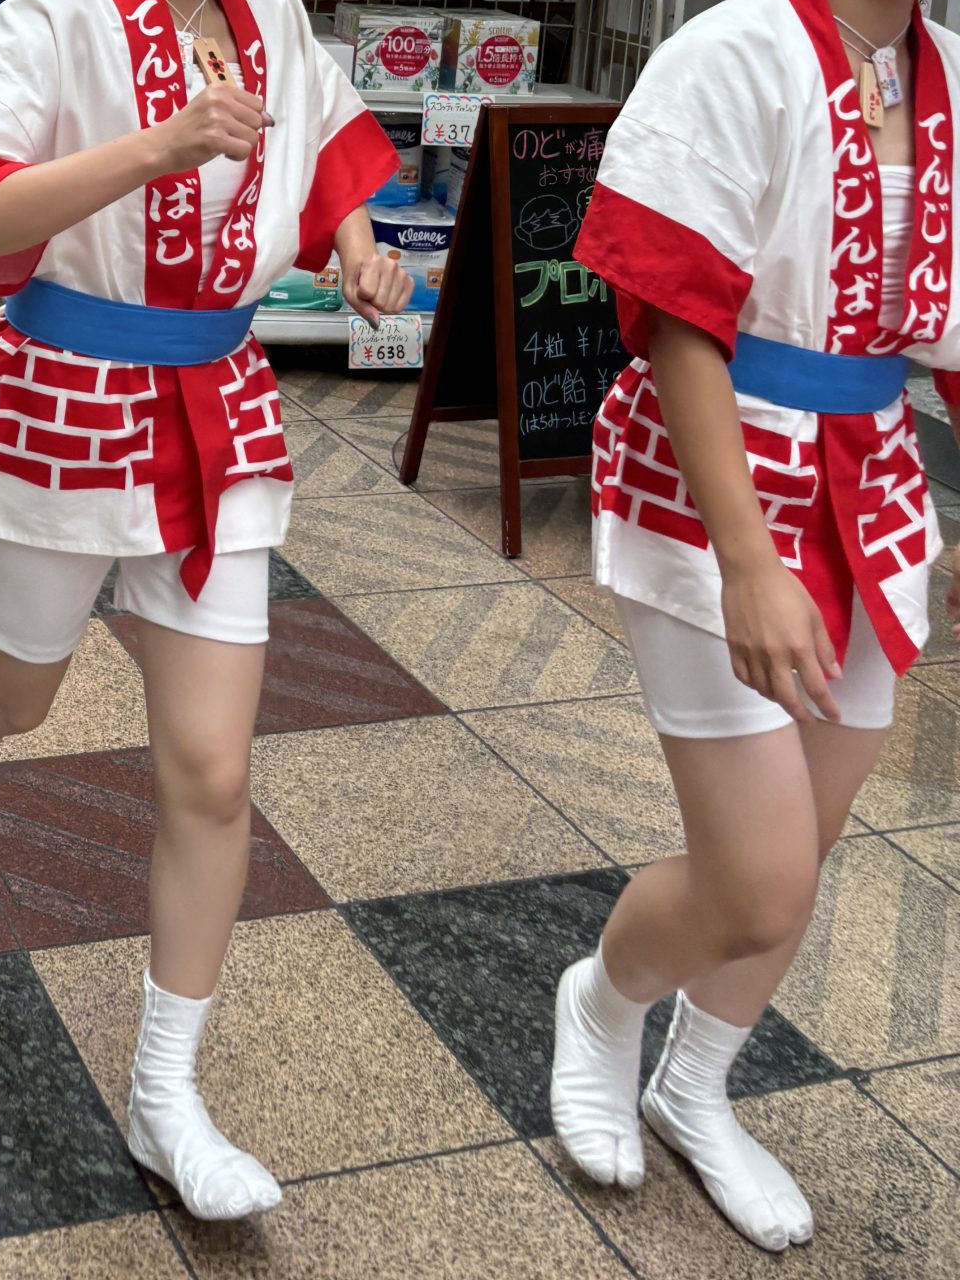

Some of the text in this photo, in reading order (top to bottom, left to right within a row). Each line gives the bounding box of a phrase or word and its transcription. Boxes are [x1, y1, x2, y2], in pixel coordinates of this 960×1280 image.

[397, 227, 447, 246] Kleenex
[363, 344, 406, 363] ¥638
[523, 330, 567, 366] 4粒
[522, 367, 587, 410] のど飴
